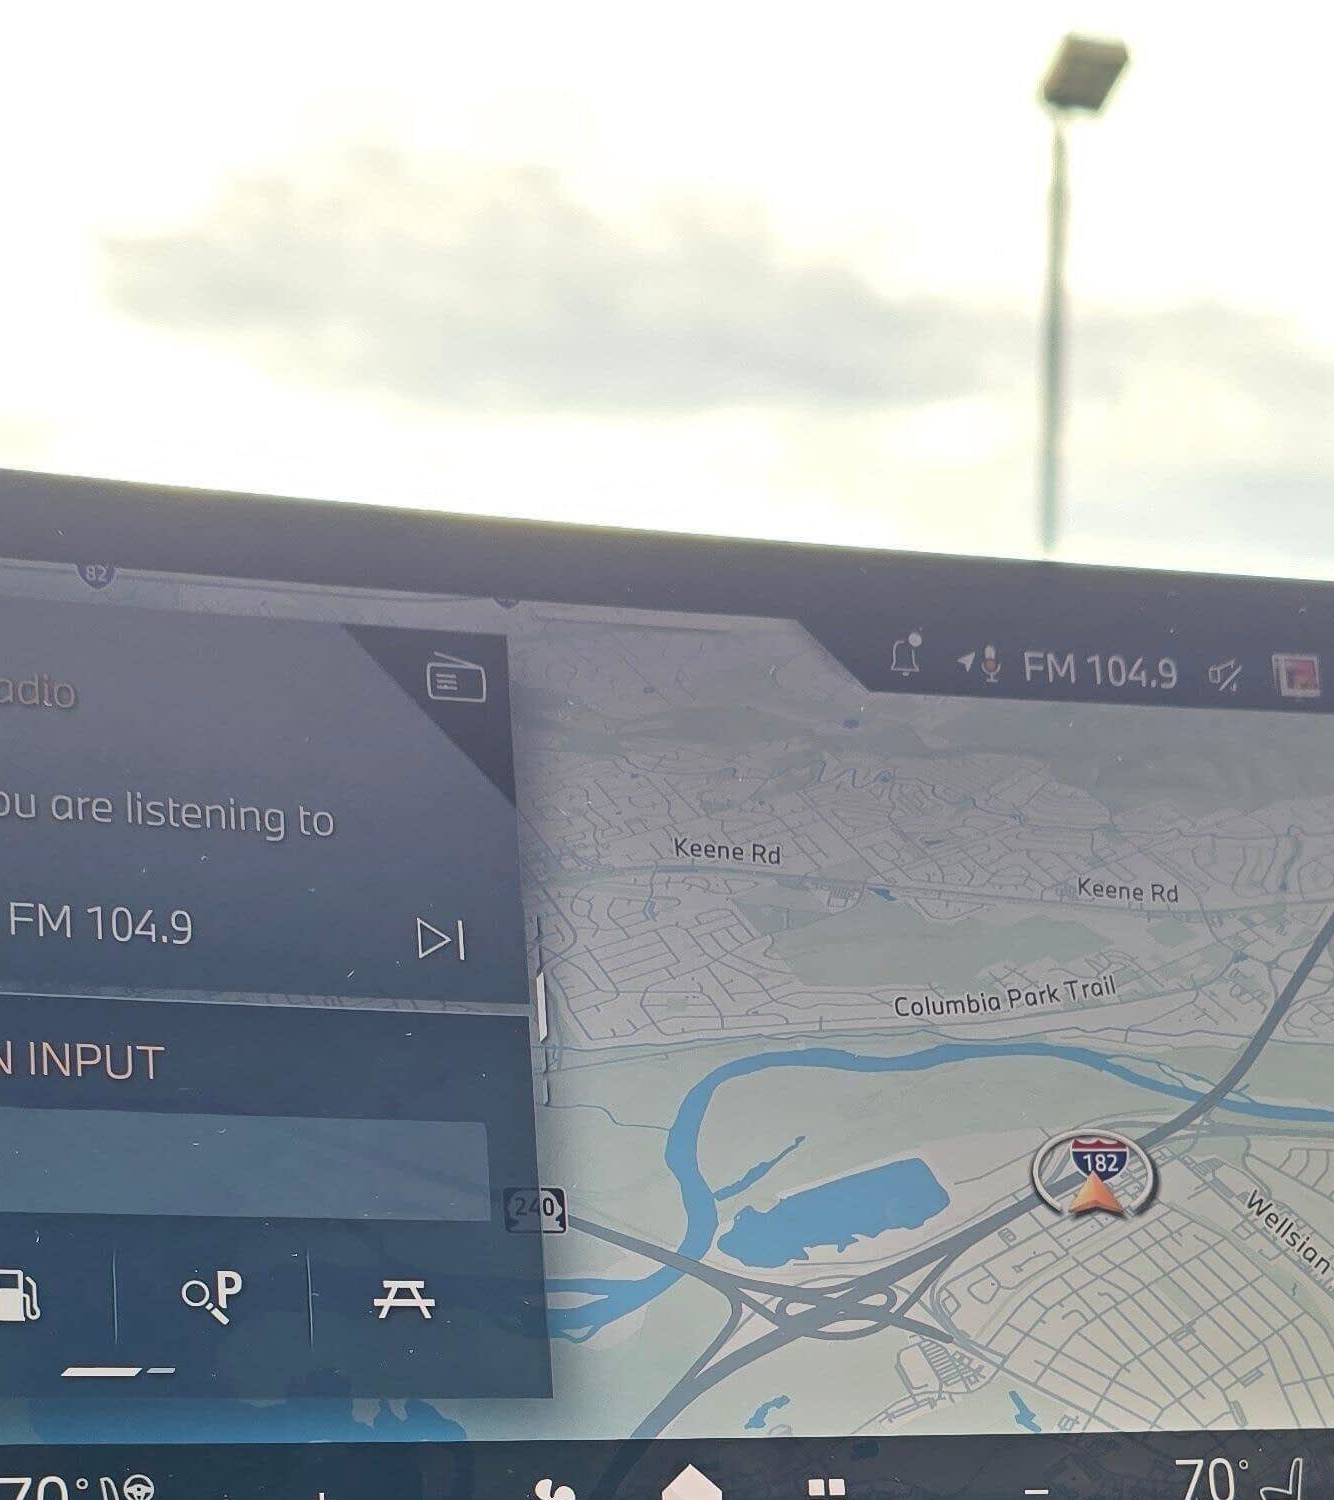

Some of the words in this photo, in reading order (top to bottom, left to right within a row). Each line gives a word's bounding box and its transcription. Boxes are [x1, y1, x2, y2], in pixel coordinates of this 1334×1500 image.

[1023, 650, 1076, 684] FM
[1087, 655, 1179, 690] 104.9
[51, 793, 113, 823] are
[126, 791, 286, 842] listening
[298, 805, 335, 837] to
[674, 837, 744, 862] Keene
[751, 844, 782, 866] Rd
[1078, 877, 1144, 902] Keene
[1150, 884, 1179, 904] Rd
[9, 902, 73, 938] FM
[86, 905, 193, 945] 104.9
[894, 991, 1001, 1017] Columbia
[1007, 983, 1061, 1010] Park
[1063, 975, 1117, 1002] Trail
[28, 1041, 166, 1080] INPUT
[1082, 1153, 1119, 1173] 182
[515, 1197, 555, 1217] 240
[1245, 1188, 1332, 1280] Wellsian
